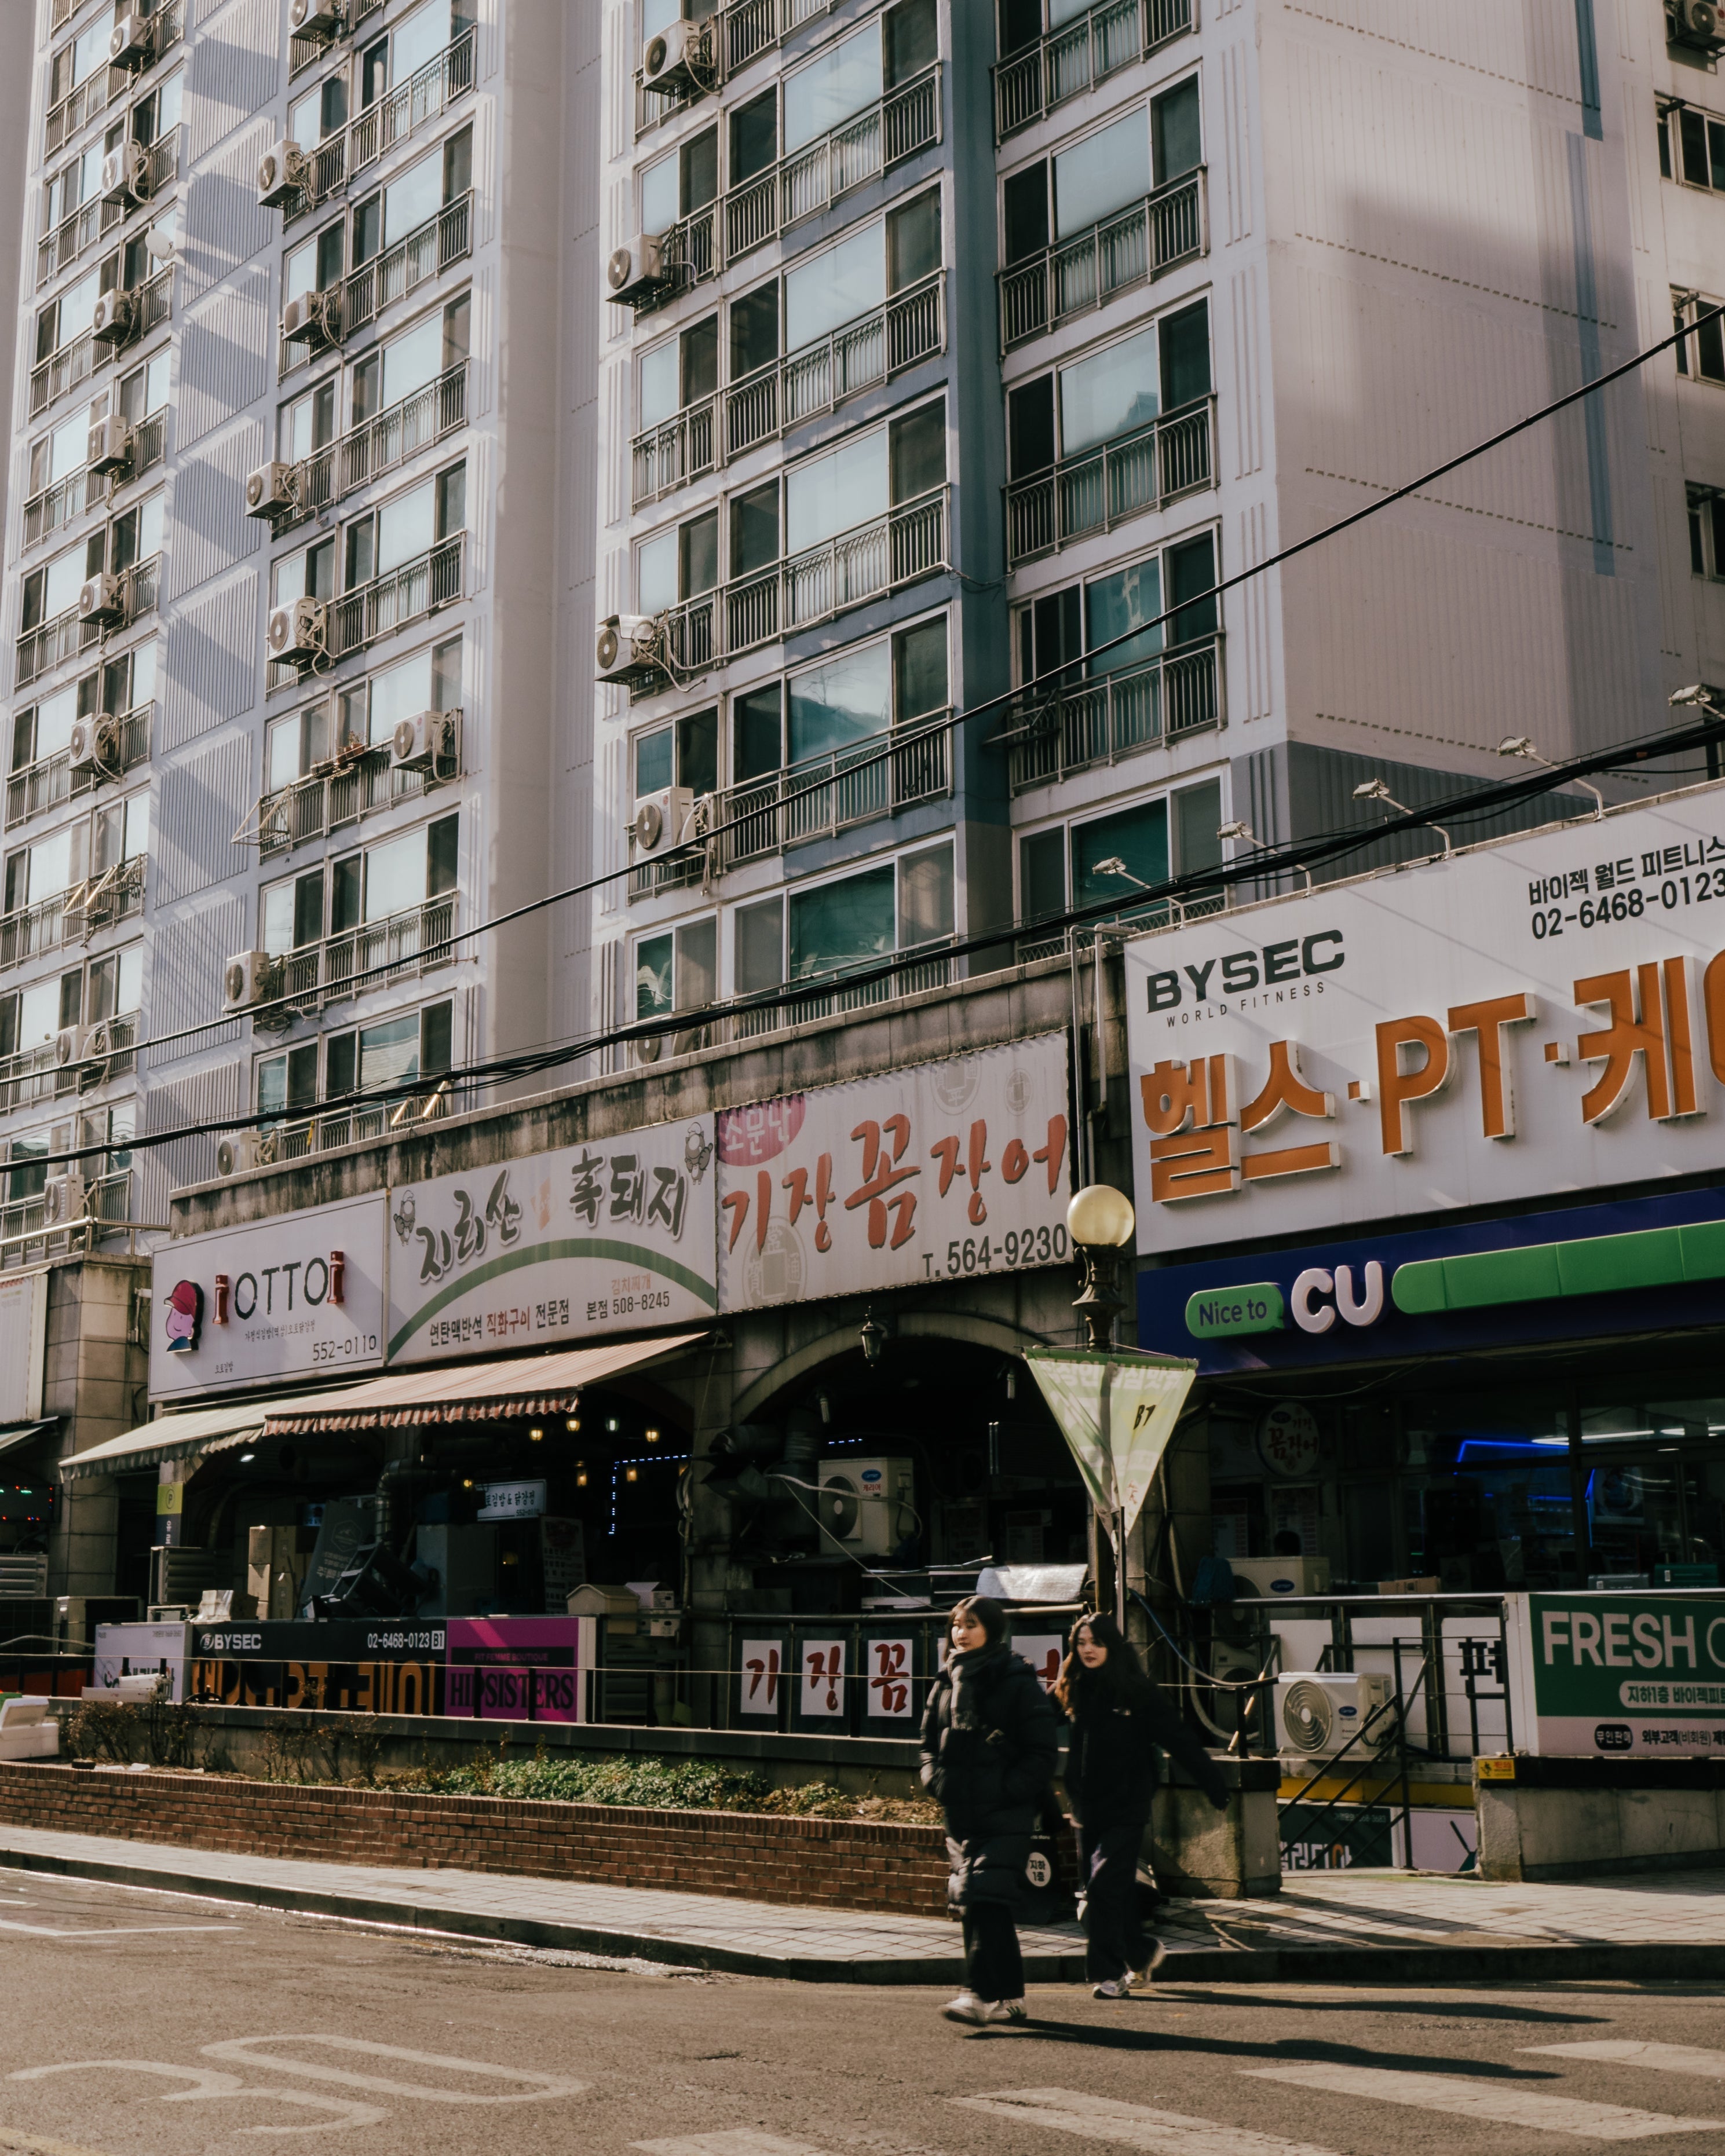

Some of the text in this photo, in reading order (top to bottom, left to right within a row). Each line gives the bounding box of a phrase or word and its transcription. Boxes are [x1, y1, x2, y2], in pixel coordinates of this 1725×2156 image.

[1528, 836, 1725, 906] 바이젝 월드 피트니스
[1532, 867, 1725, 939] 02-6468-0123
[1146, 929, 1345, 1013] BYSEC
[1167, 982, 1324, 1028] WORLD FITNESS
[724, 1099, 792, 1156] 소문난
[416, 1147, 686, 1281] 지리산 흑돼지
[946, 1222, 1068, 1276] 564-9230
[611, 1273, 652, 1296] 김치찌개
[1291, 1260, 1384, 1334] CU
[486, 1305, 531, 1338] 직화구이
[535, 1298, 569, 1329] 전문점
[586, 1299, 608, 1321] 본점
[613, 1291, 670, 1315] 508-8245
[1198, 1298, 1267, 1327] Nice to
[313, 1334, 377, 1361] 552-0110
[214, 1633, 262, 1650] BYSEC
[367, 1632, 430, 1650] 02-6468-0123
[1542, 1610, 1697, 1668] FRESH
[1627, 1686, 1670, 1704] 지하1층
